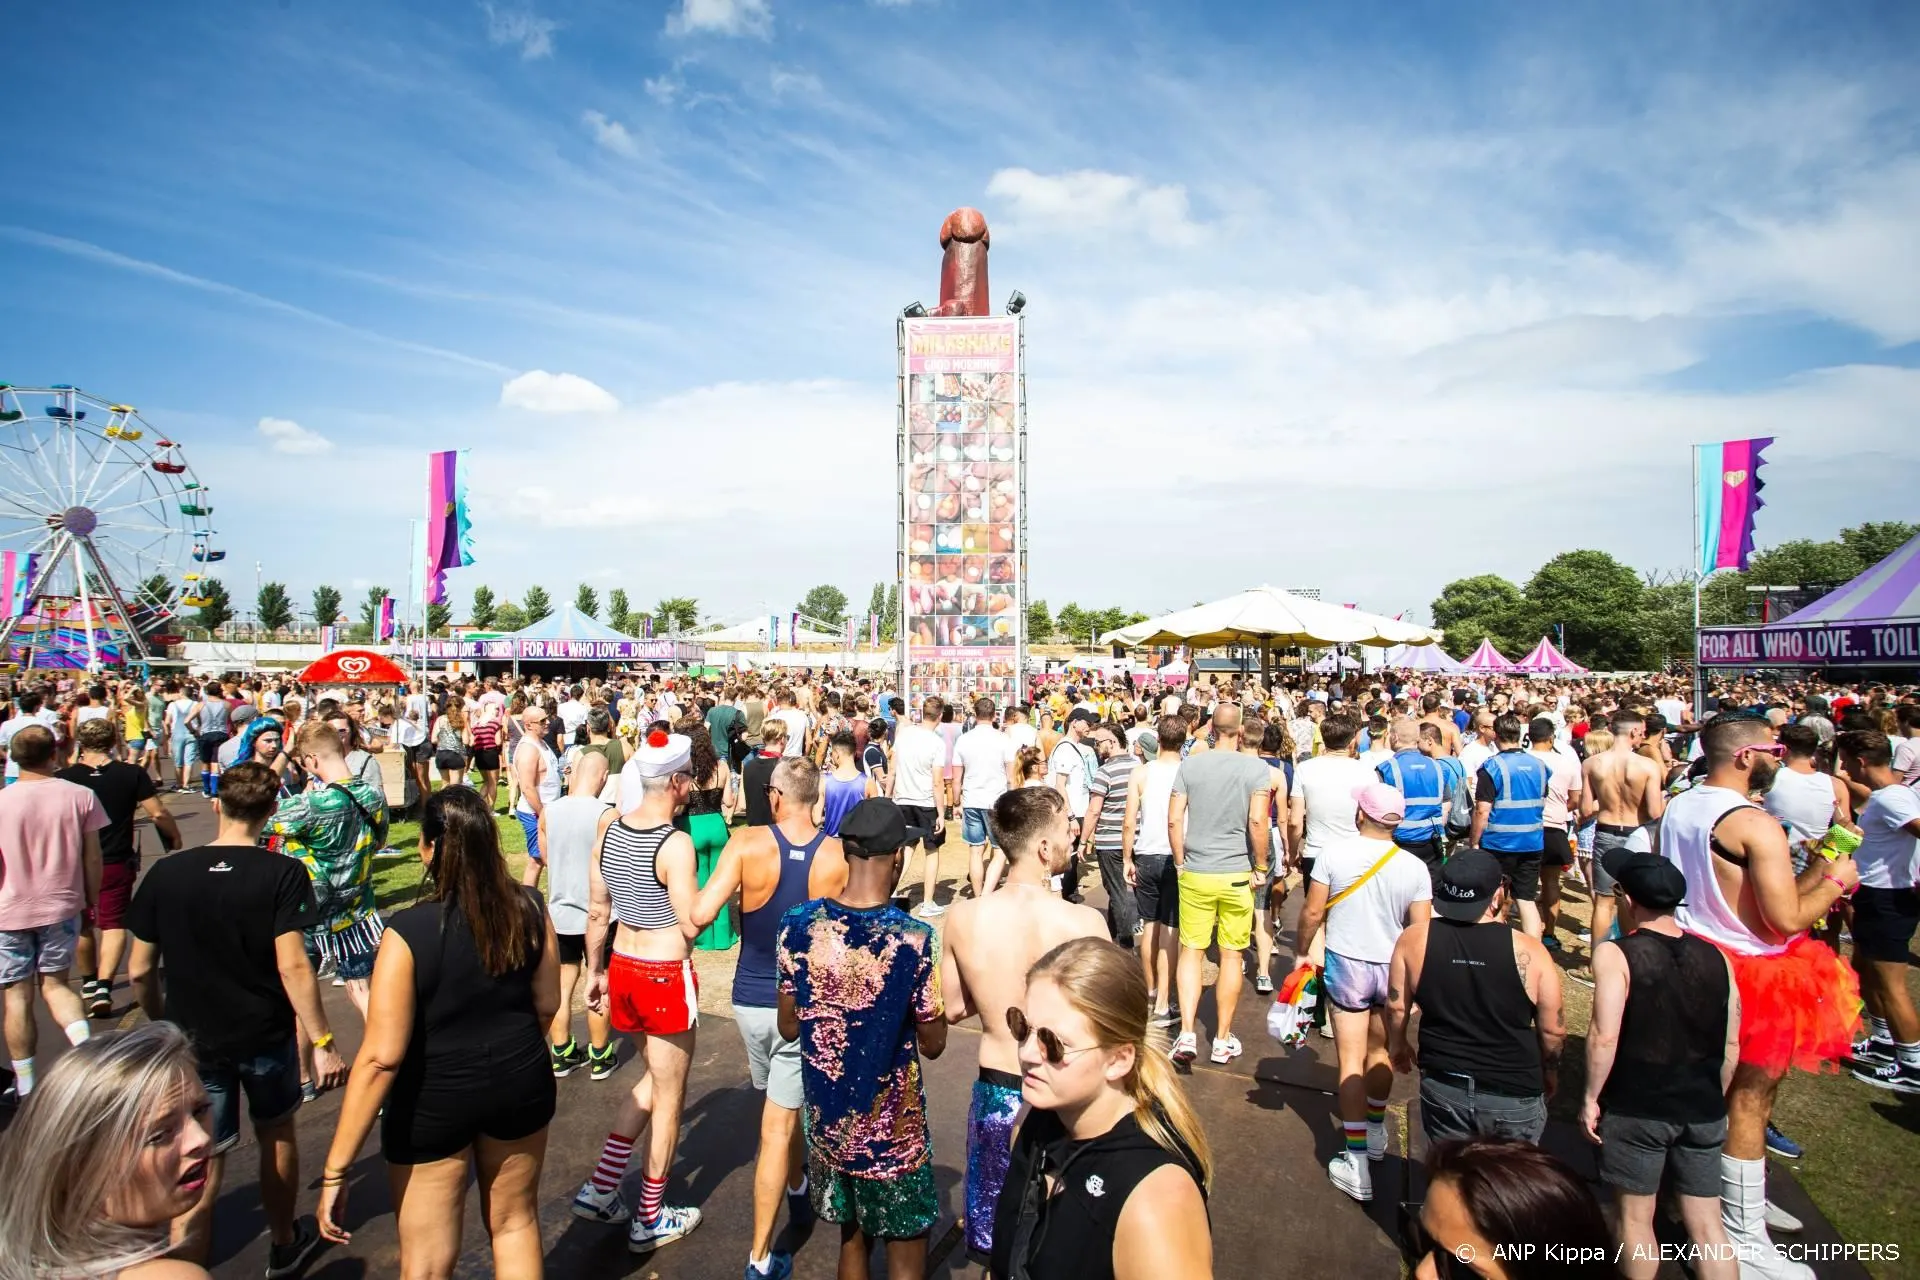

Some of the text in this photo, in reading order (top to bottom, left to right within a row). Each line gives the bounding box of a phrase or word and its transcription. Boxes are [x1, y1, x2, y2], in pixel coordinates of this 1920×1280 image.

[924, 359, 950, 371] GOOD
[429, 642, 441, 657] ALL
[442, 642, 458, 657] WHO
[523, 641, 544, 658] FOR
[546, 641, 565, 658] ALL
[568, 641, 596, 658] WHO
[597, 641, 629, 658] LOVE..
[1702, 626, 1920, 658] FOR ALL WHO LOVE.. TOIL
